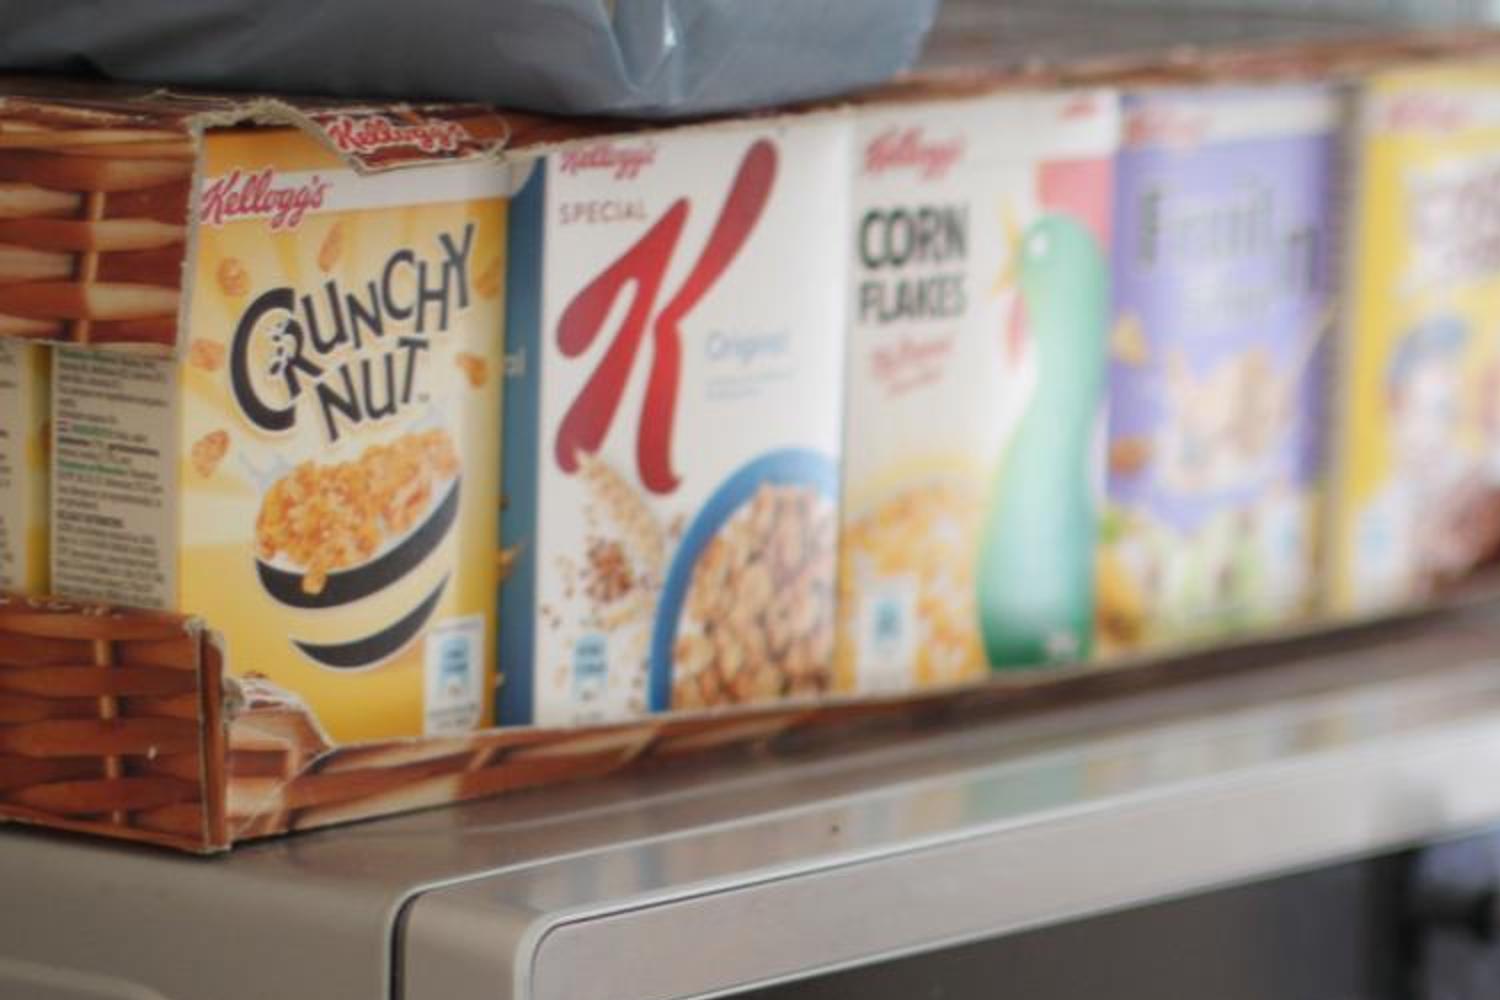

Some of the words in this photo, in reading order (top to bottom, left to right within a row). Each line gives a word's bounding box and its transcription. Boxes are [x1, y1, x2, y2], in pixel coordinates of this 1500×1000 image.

[200, 168, 326, 228] Kellogg's
[558, 200, 648, 226] SPECIAL
[858, 204, 968, 271] CORN
[229, 223, 476, 432] CRUNCHY
[554, 136, 780, 496] K
[858, 273, 968, 325] FLAKES
[315, 337, 431, 442] NUT
